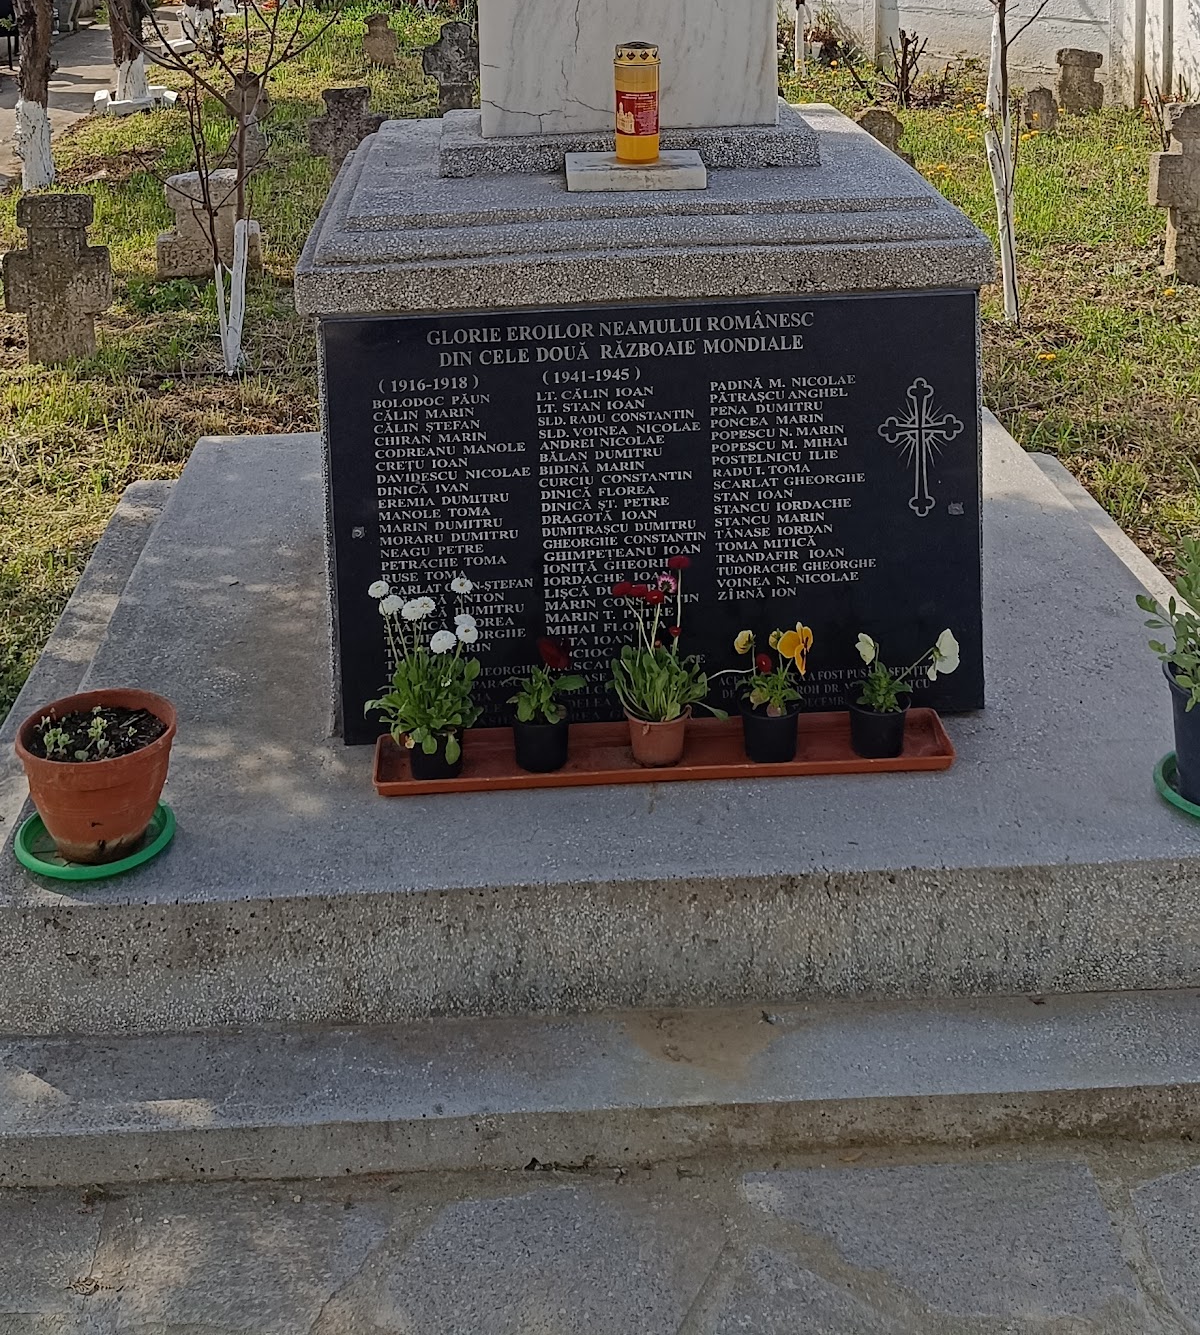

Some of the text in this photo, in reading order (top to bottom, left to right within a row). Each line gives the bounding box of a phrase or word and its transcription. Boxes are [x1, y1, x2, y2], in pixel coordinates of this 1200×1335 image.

[426, 310, 815, 345] GLORIE EROILOR NEAMULUI ROMÂNESC
[439, 335, 804, 367] DIN CELE DOUĂ RĂZBOAIE MONDIALE
[709, 374, 856, 391] PADINĂ M. NICOLAE
[561, 388, 609, 400] CĂLIN
[615, 386, 654, 397] IOAN
[788, 387, 848, 400] ANGHEL
[372, 393, 490, 409] BOLODOC PĂUN
[562, 401, 600, 413] STAN
[607, 399, 645, 410] IOAN
[710, 401, 823, 416] PENA DUMITRU
[373, 407, 475, 421] CĂLIN MARIN
[569, 414, 606, 425] RADU
[611, 409, 695, 423] CONSTANTIN
[710, 413, 824, 428] PONCEA MARIN
[373, 422, 419, 434] CĂLIN
[572, 425, 628, 437] VOINEA
[636, 421, 701, 434] NICOLAE
[710, 424, 845, 440] POPESCU N. MARIN
[374, 431, 487, 446] CHIRAN MARIN
[539, 435, 665, 450] ANDREI NICOLAE
[711, 437, 848, 453] POPESCU M. MIHAI
[374, 442, 526, 459] CODREANU MANOLE
[539, 447, 663, 463] BĂLAN DUMITRU
[711, 449, 839, 465] POSTELNICU ILIE
[432, 458, 468, 469] IOAN
[539, 460, 645, 475] BIDINĂ MARIN
[712, 467, 752, 478] RADU
[768, 464, 811, 475] TOMA
[376, 467, 531, 484] DAVIDESCU NICOLAE
[538, 470, 693, 487] CURCIU CONSTANTIN
[713, 472, 866, 490] SCARLAT GHEORGHE
[435, 483, 469, 493] IVAN
[540, 485, 656, 500] DINICĂ FLOREA
[713, 488, 793, 502] STAN IOAN
[378, 492, 510, 509] EREMIA DUMITRU
[541, 499, 592, 512] DINICĂ
[623, 496, 670, 508] PETRE
[713, 498, 852, 514] STANCU IORDACHE
[378, 507, 491, 521] MANOLE TOMA
[621, 509, 657, 521] IOAN
[714, 512, 825, 527] STANCU MARIN
[379, 518, 503, 533] MARIN DUMITRU
[634, 519, 697, 532] DUMITRU
[714, 524, 833, 539] TĂNASE IORDAN
[379, 529, 519, 546] MORARU DUMITRU
[542, 531, 707, 549] GHEORGHE CONSTANTIN
[715, 535, 817, 551] TOMA MITICĂ
[380, 544, 484, 558] NEAGU PETRE
[663, 543, 701, 555] IOAN
[716, 547, 845, 564] TRANDAFIR IOAN
[463, 555, 507, 567] TOMA
[716, 558, 877, 576] TUDORACHE GHEORGHE
[543, 572, 625, 586] IORDACHE
[716, 571, 859, 588] VOINEA N. NICOLAE
[389, 583, 442, 595] CARLAT
[771, 587, 797, 598] ION
[545, 599, 597, 611] MARIN
[545, 611, 599, 623] MARIN
[546, 624, 596, 635] MIHAI
